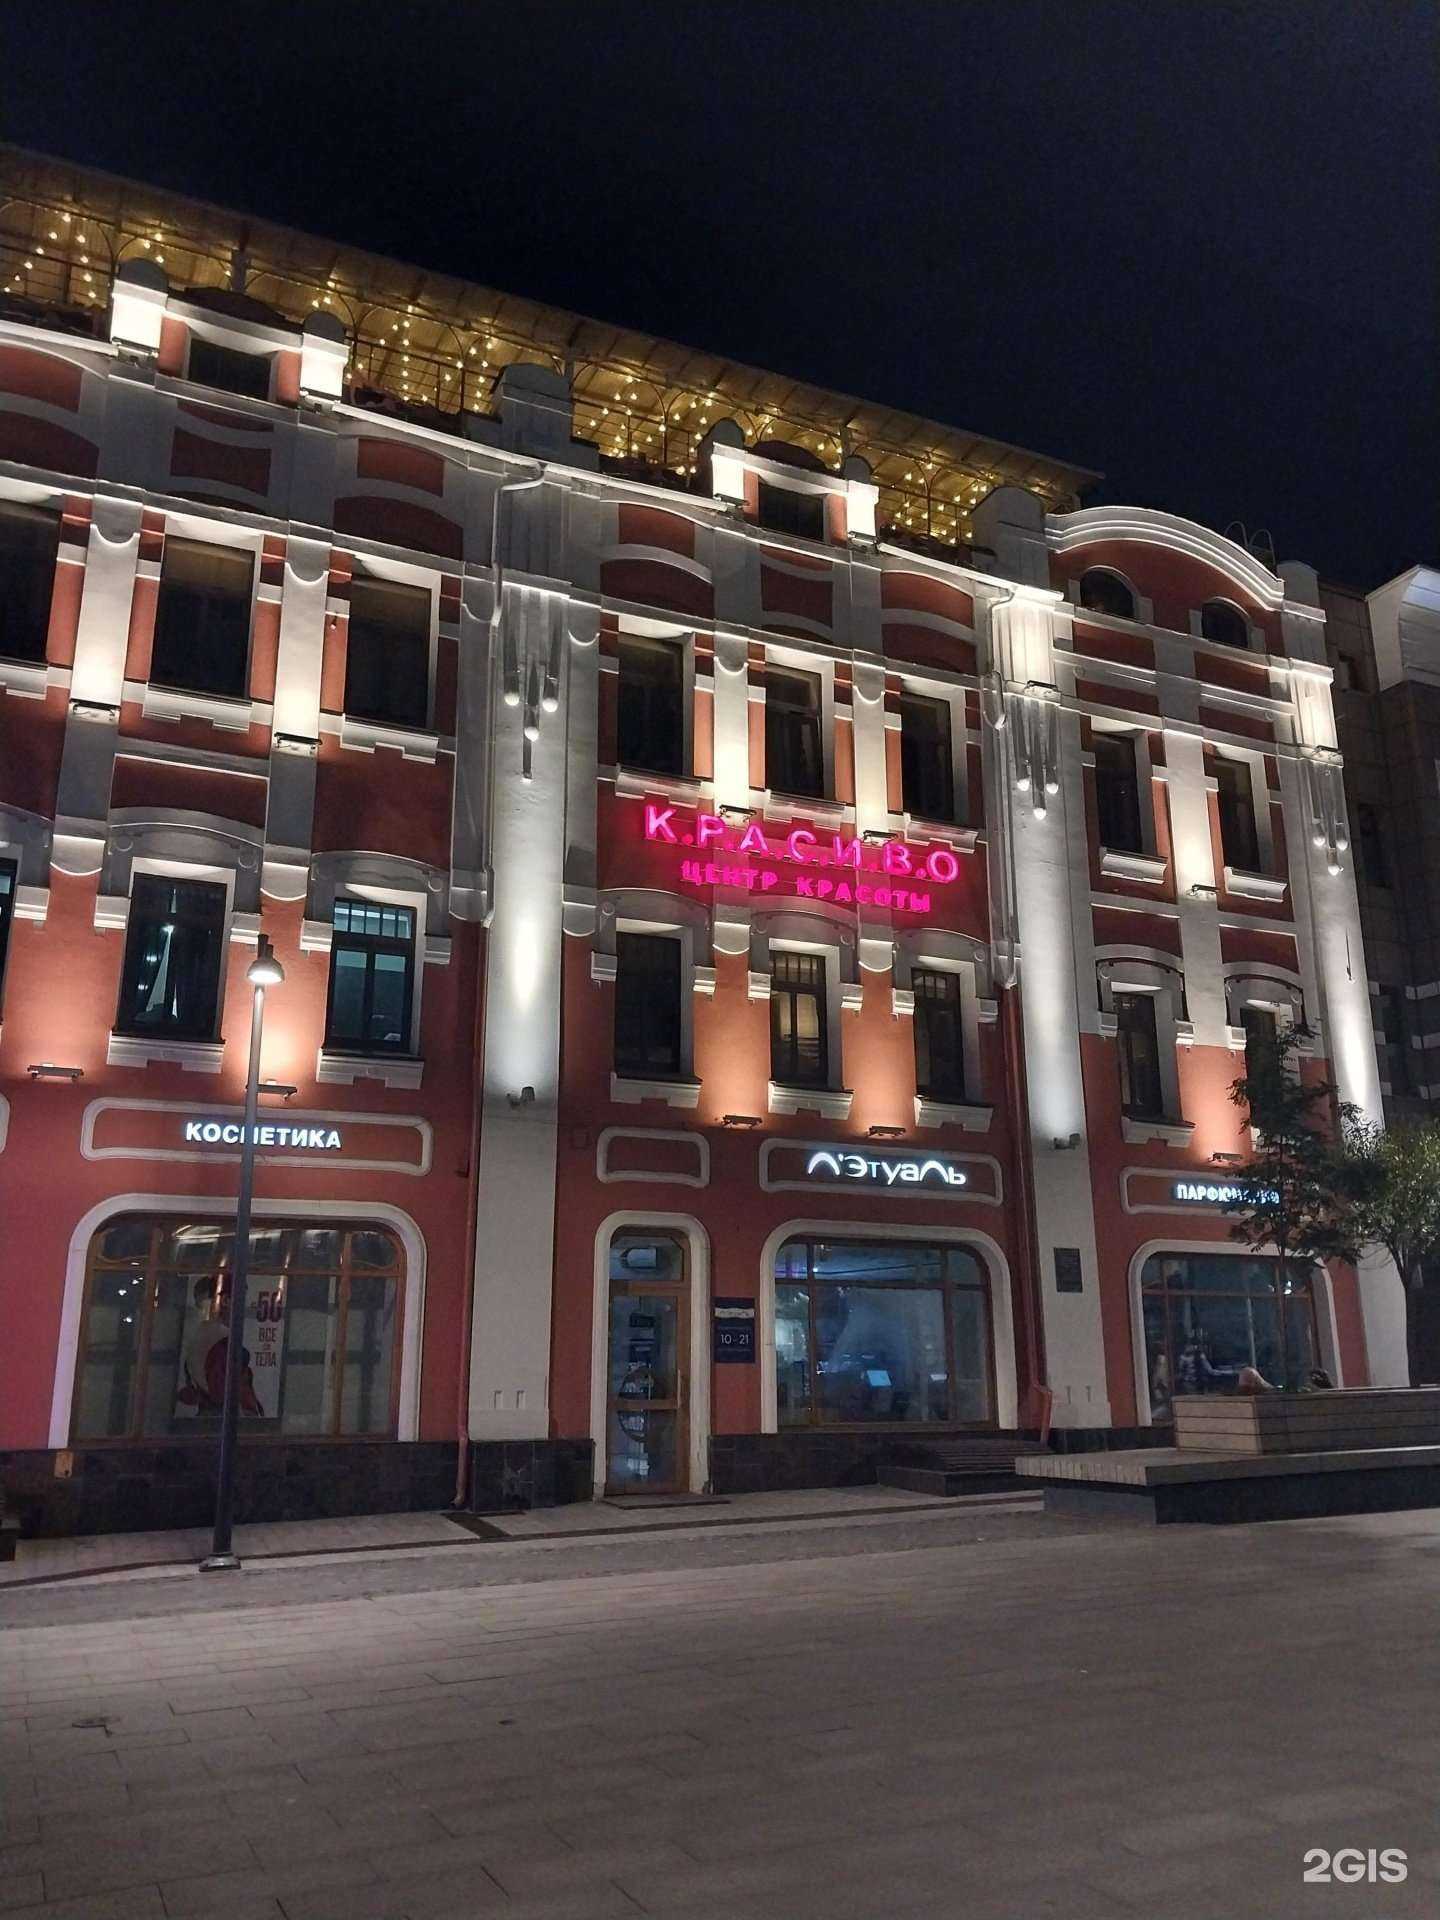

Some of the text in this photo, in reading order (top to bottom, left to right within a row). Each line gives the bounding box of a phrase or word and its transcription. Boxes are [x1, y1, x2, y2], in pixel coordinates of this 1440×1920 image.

[680, 860, 931, 913] ЦЕНТР КРАСОТЫ
[720, 1334, 732, 1345] 10
[739, 1334, 749, 1345] 21
